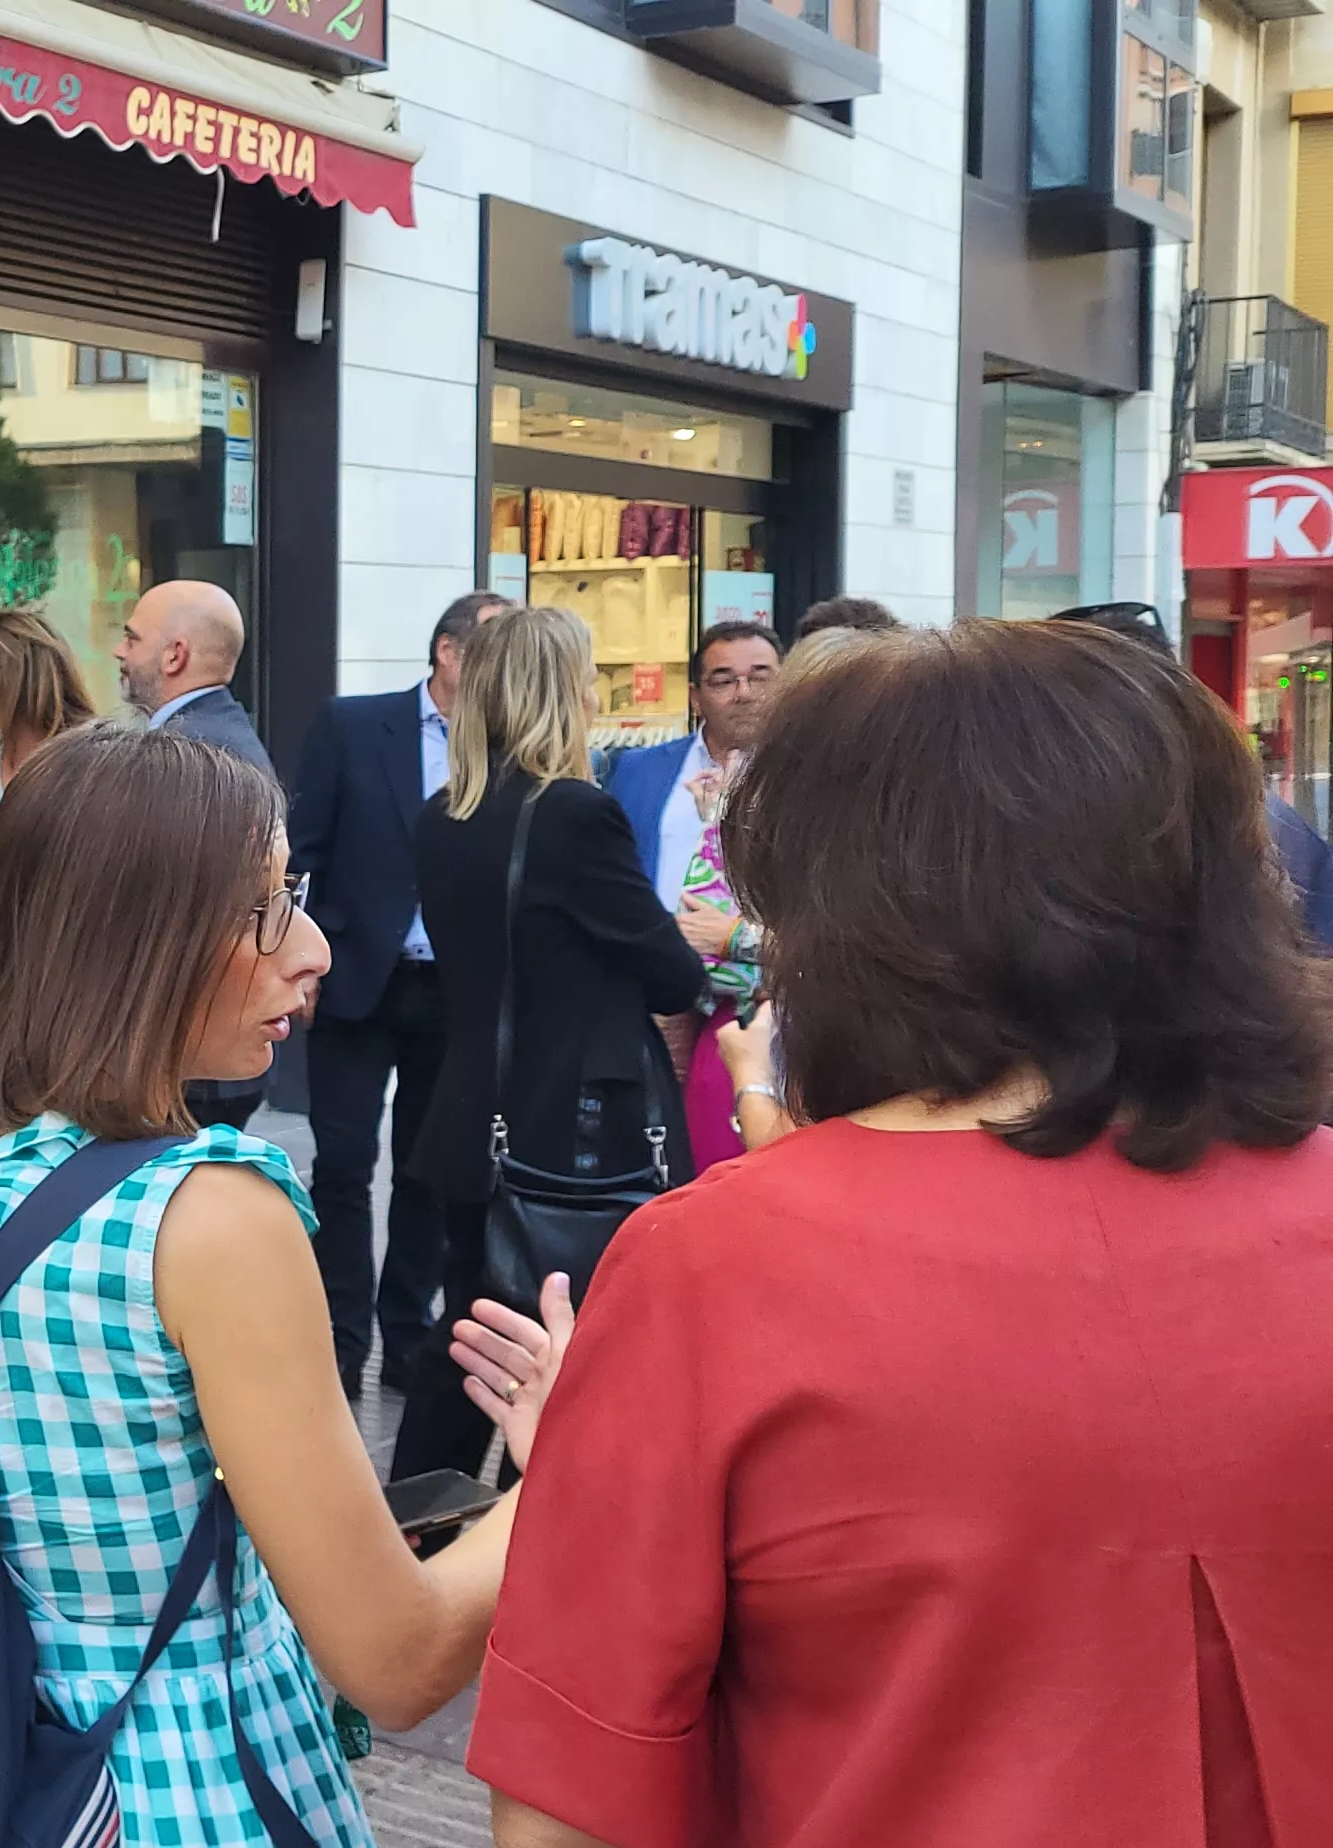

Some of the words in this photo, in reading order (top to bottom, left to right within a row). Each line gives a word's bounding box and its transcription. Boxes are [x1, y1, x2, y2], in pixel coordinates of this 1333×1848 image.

[53, 73, 81, 115] 2
[126, 86, 316, 183] CAFETERIA
[1246, 495, 1320, 559] K
